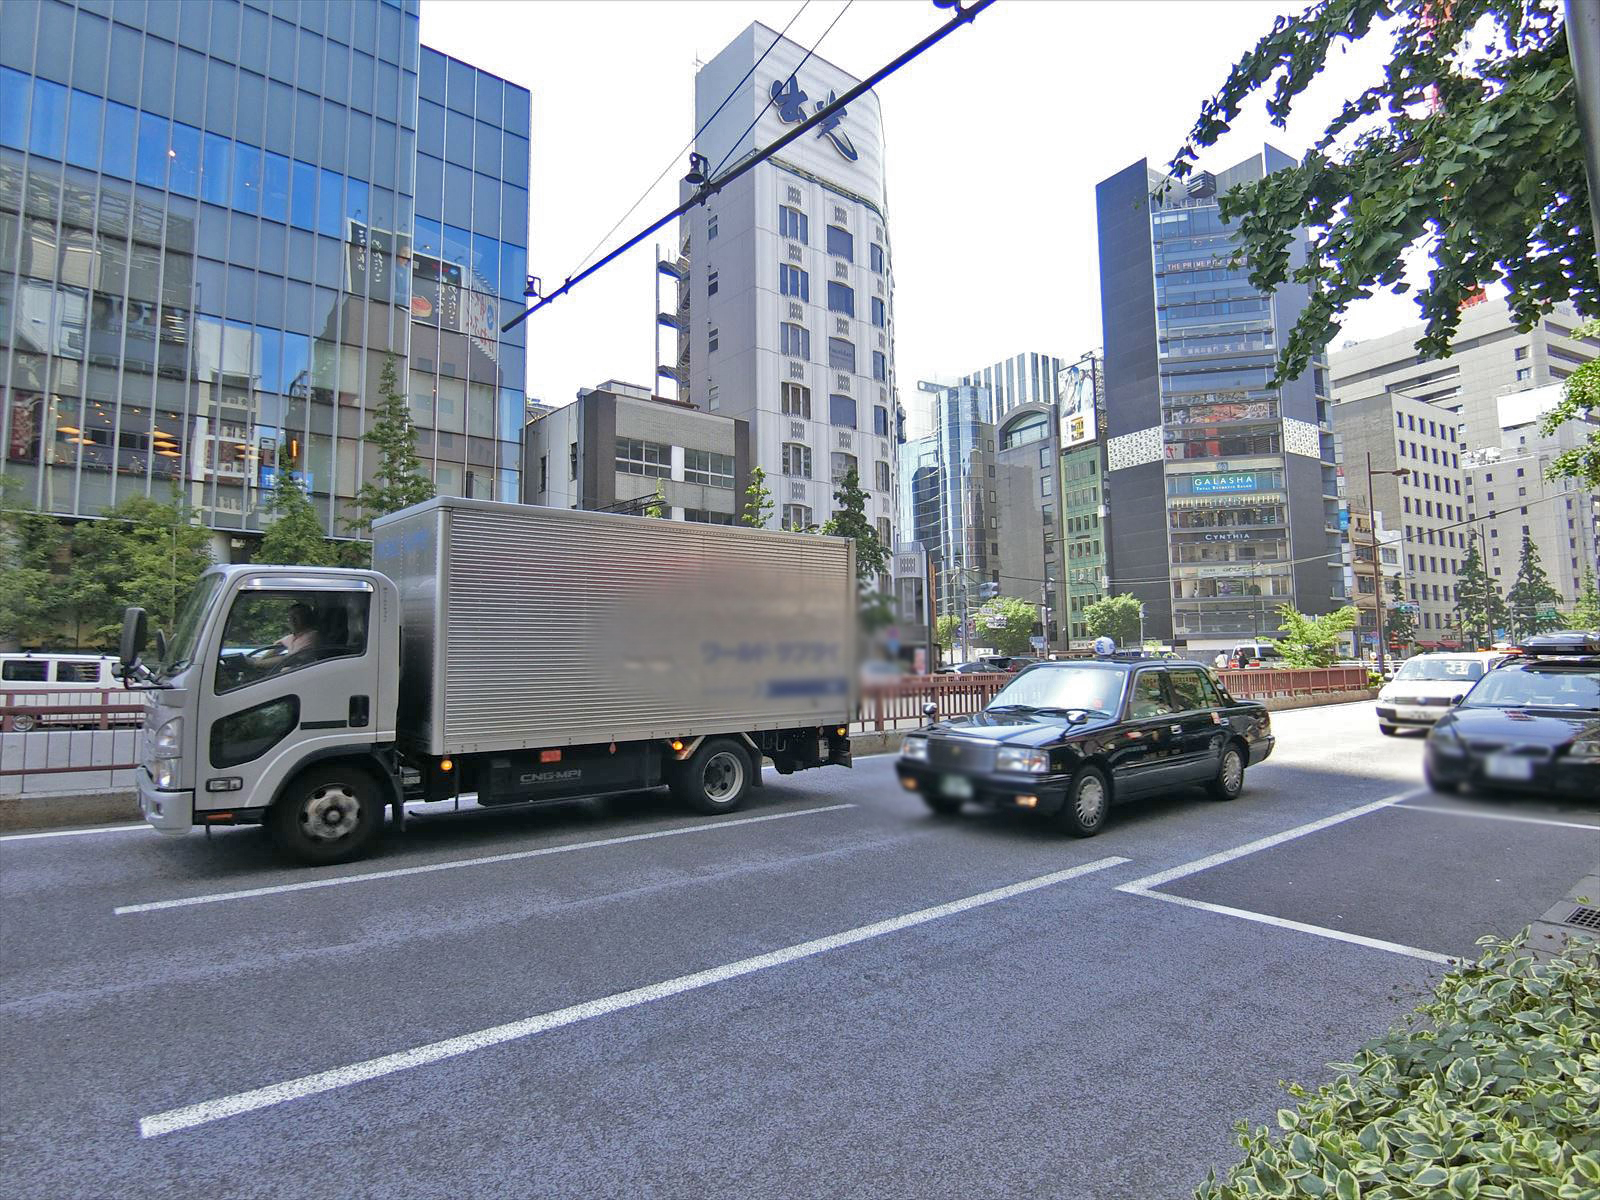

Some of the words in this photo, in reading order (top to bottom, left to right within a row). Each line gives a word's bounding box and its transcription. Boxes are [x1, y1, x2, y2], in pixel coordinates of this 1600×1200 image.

[1168, 263, 1179, 271] THE
[1183, 260, 1204, 269] PRIME
[1194, 476, 1253, 486] GALASHA
[1205, 533, 1250, 541] CYNTHIA
